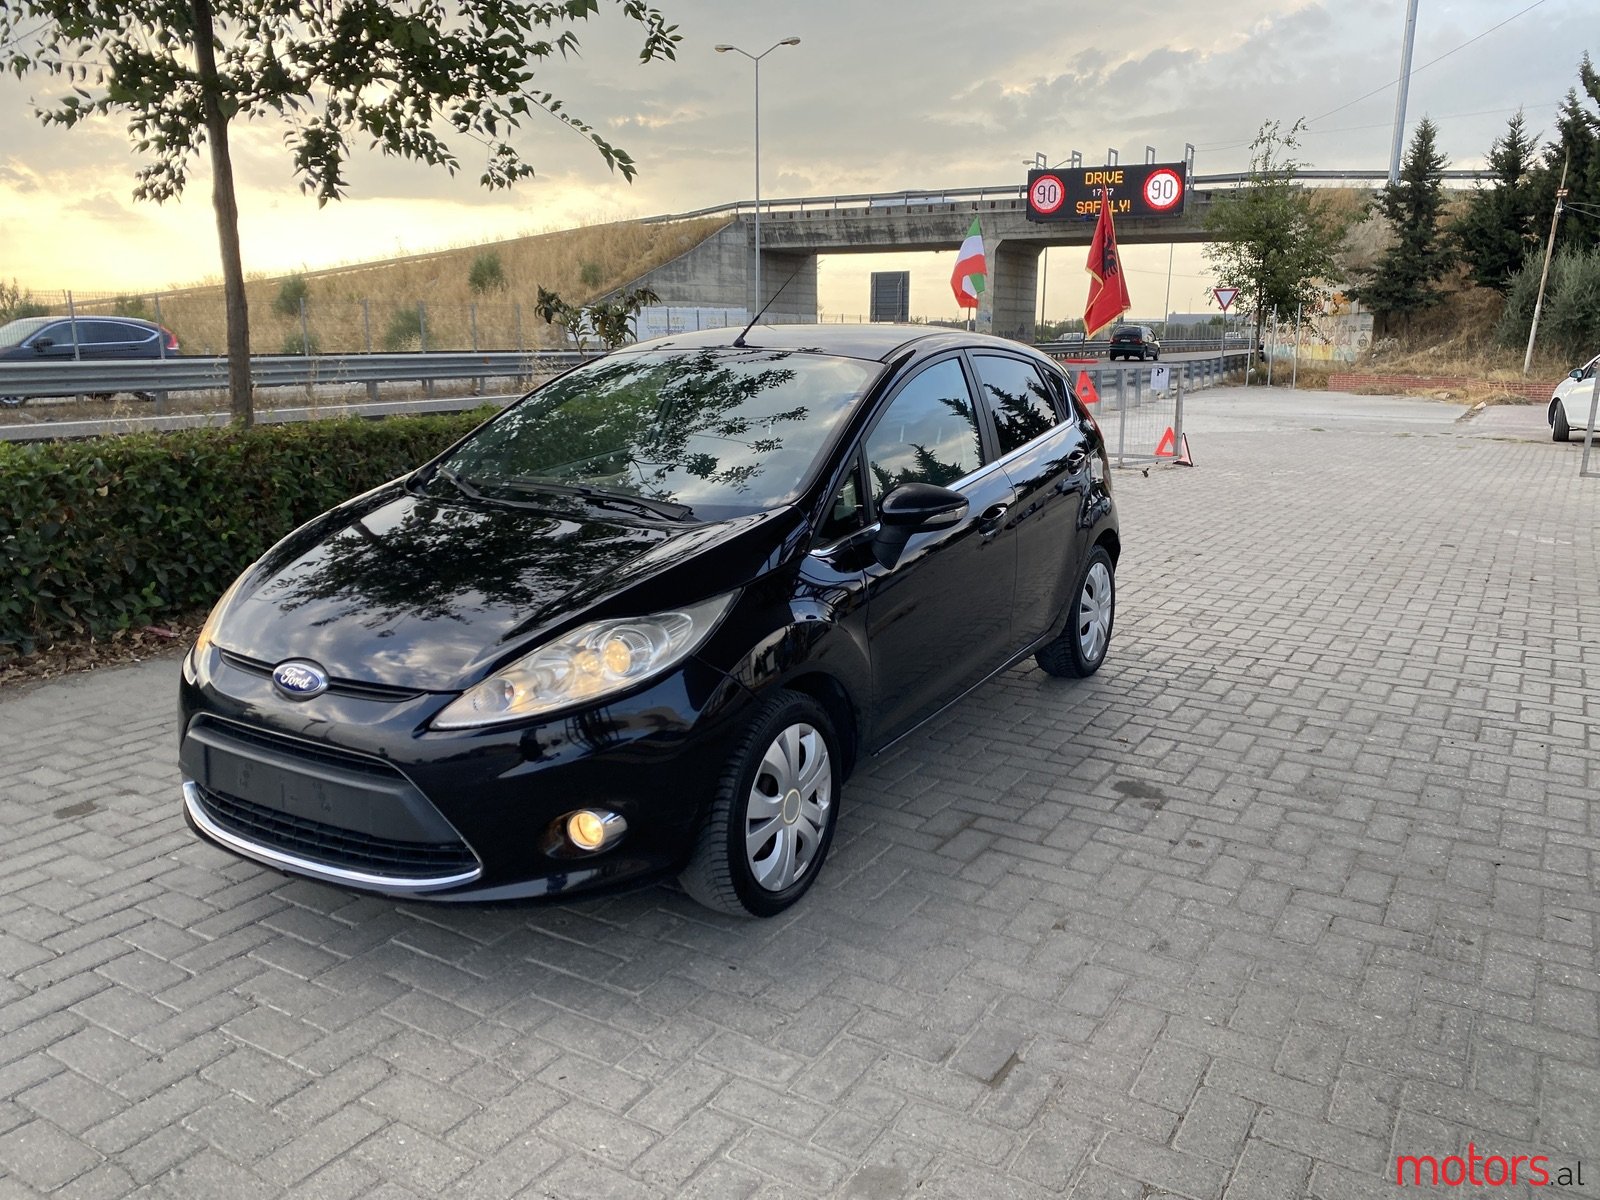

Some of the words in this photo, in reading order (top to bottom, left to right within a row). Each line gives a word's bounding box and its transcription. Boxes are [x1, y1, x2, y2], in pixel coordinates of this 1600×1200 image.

[1085, 170, 1124, 185] DRIVE
[1037, 184, 1057, 204] 90
[1151, 179, 1173, 200] 90
[1076, 199, 1131, 214] SAFLY!
[280, 667, 312, 689] Ford
